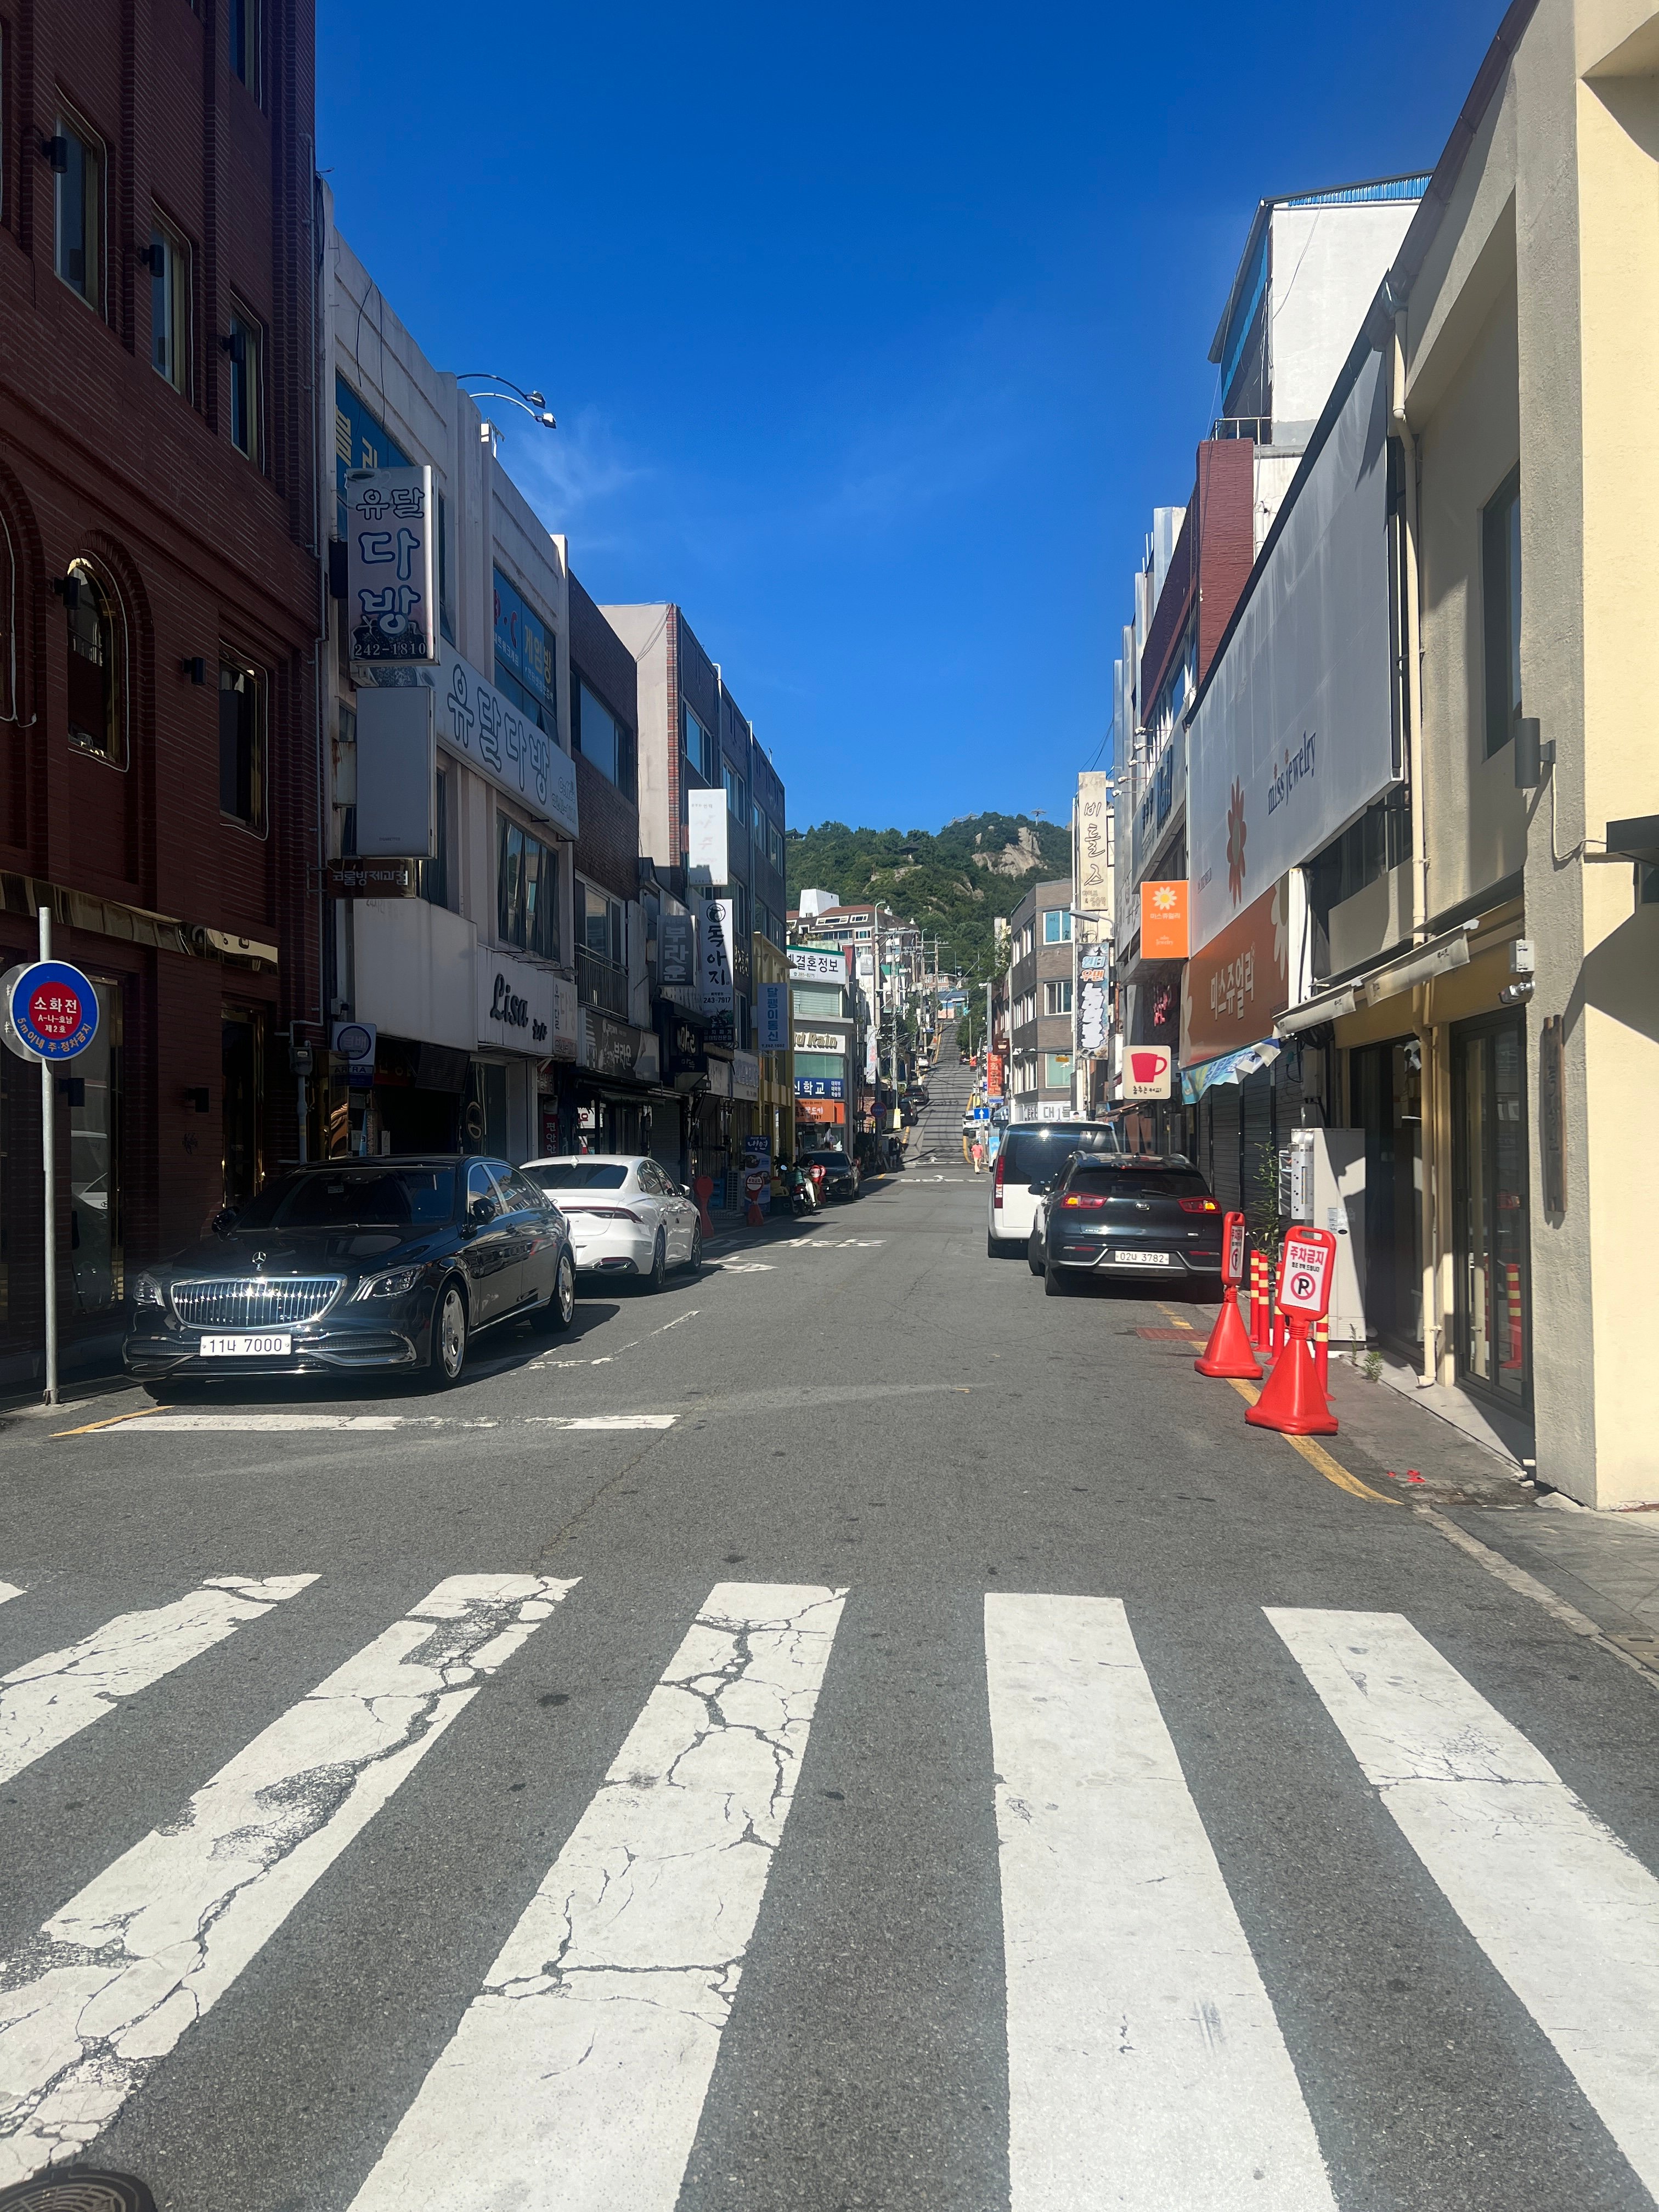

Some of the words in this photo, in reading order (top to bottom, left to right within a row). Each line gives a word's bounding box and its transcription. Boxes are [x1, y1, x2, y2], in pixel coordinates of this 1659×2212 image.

[356, 488, 425, 520] 유달
[358, 527, 421, 635] 다방
[354, 642, 426, 656] 242-1810
[524, 624, 551, 684] 게임방
[447, 663, 549, 805] 유달다방
[707, 926, 727, 986] 독아지
[33, 997, 77, 1014] 소화전
[490, 973, 528, 1028] Lisa
[767, 987, 778, 1042] 달팽이통신
[44, 1024, 66, 1034] 제2호
[1141, 1253, 1164, 1262] 3782
[1290, 1246, 1325, 1265] 주차금지
[210, 1339, 236, 1353] 11나
[244, 1338, 282, 1352] 7000
